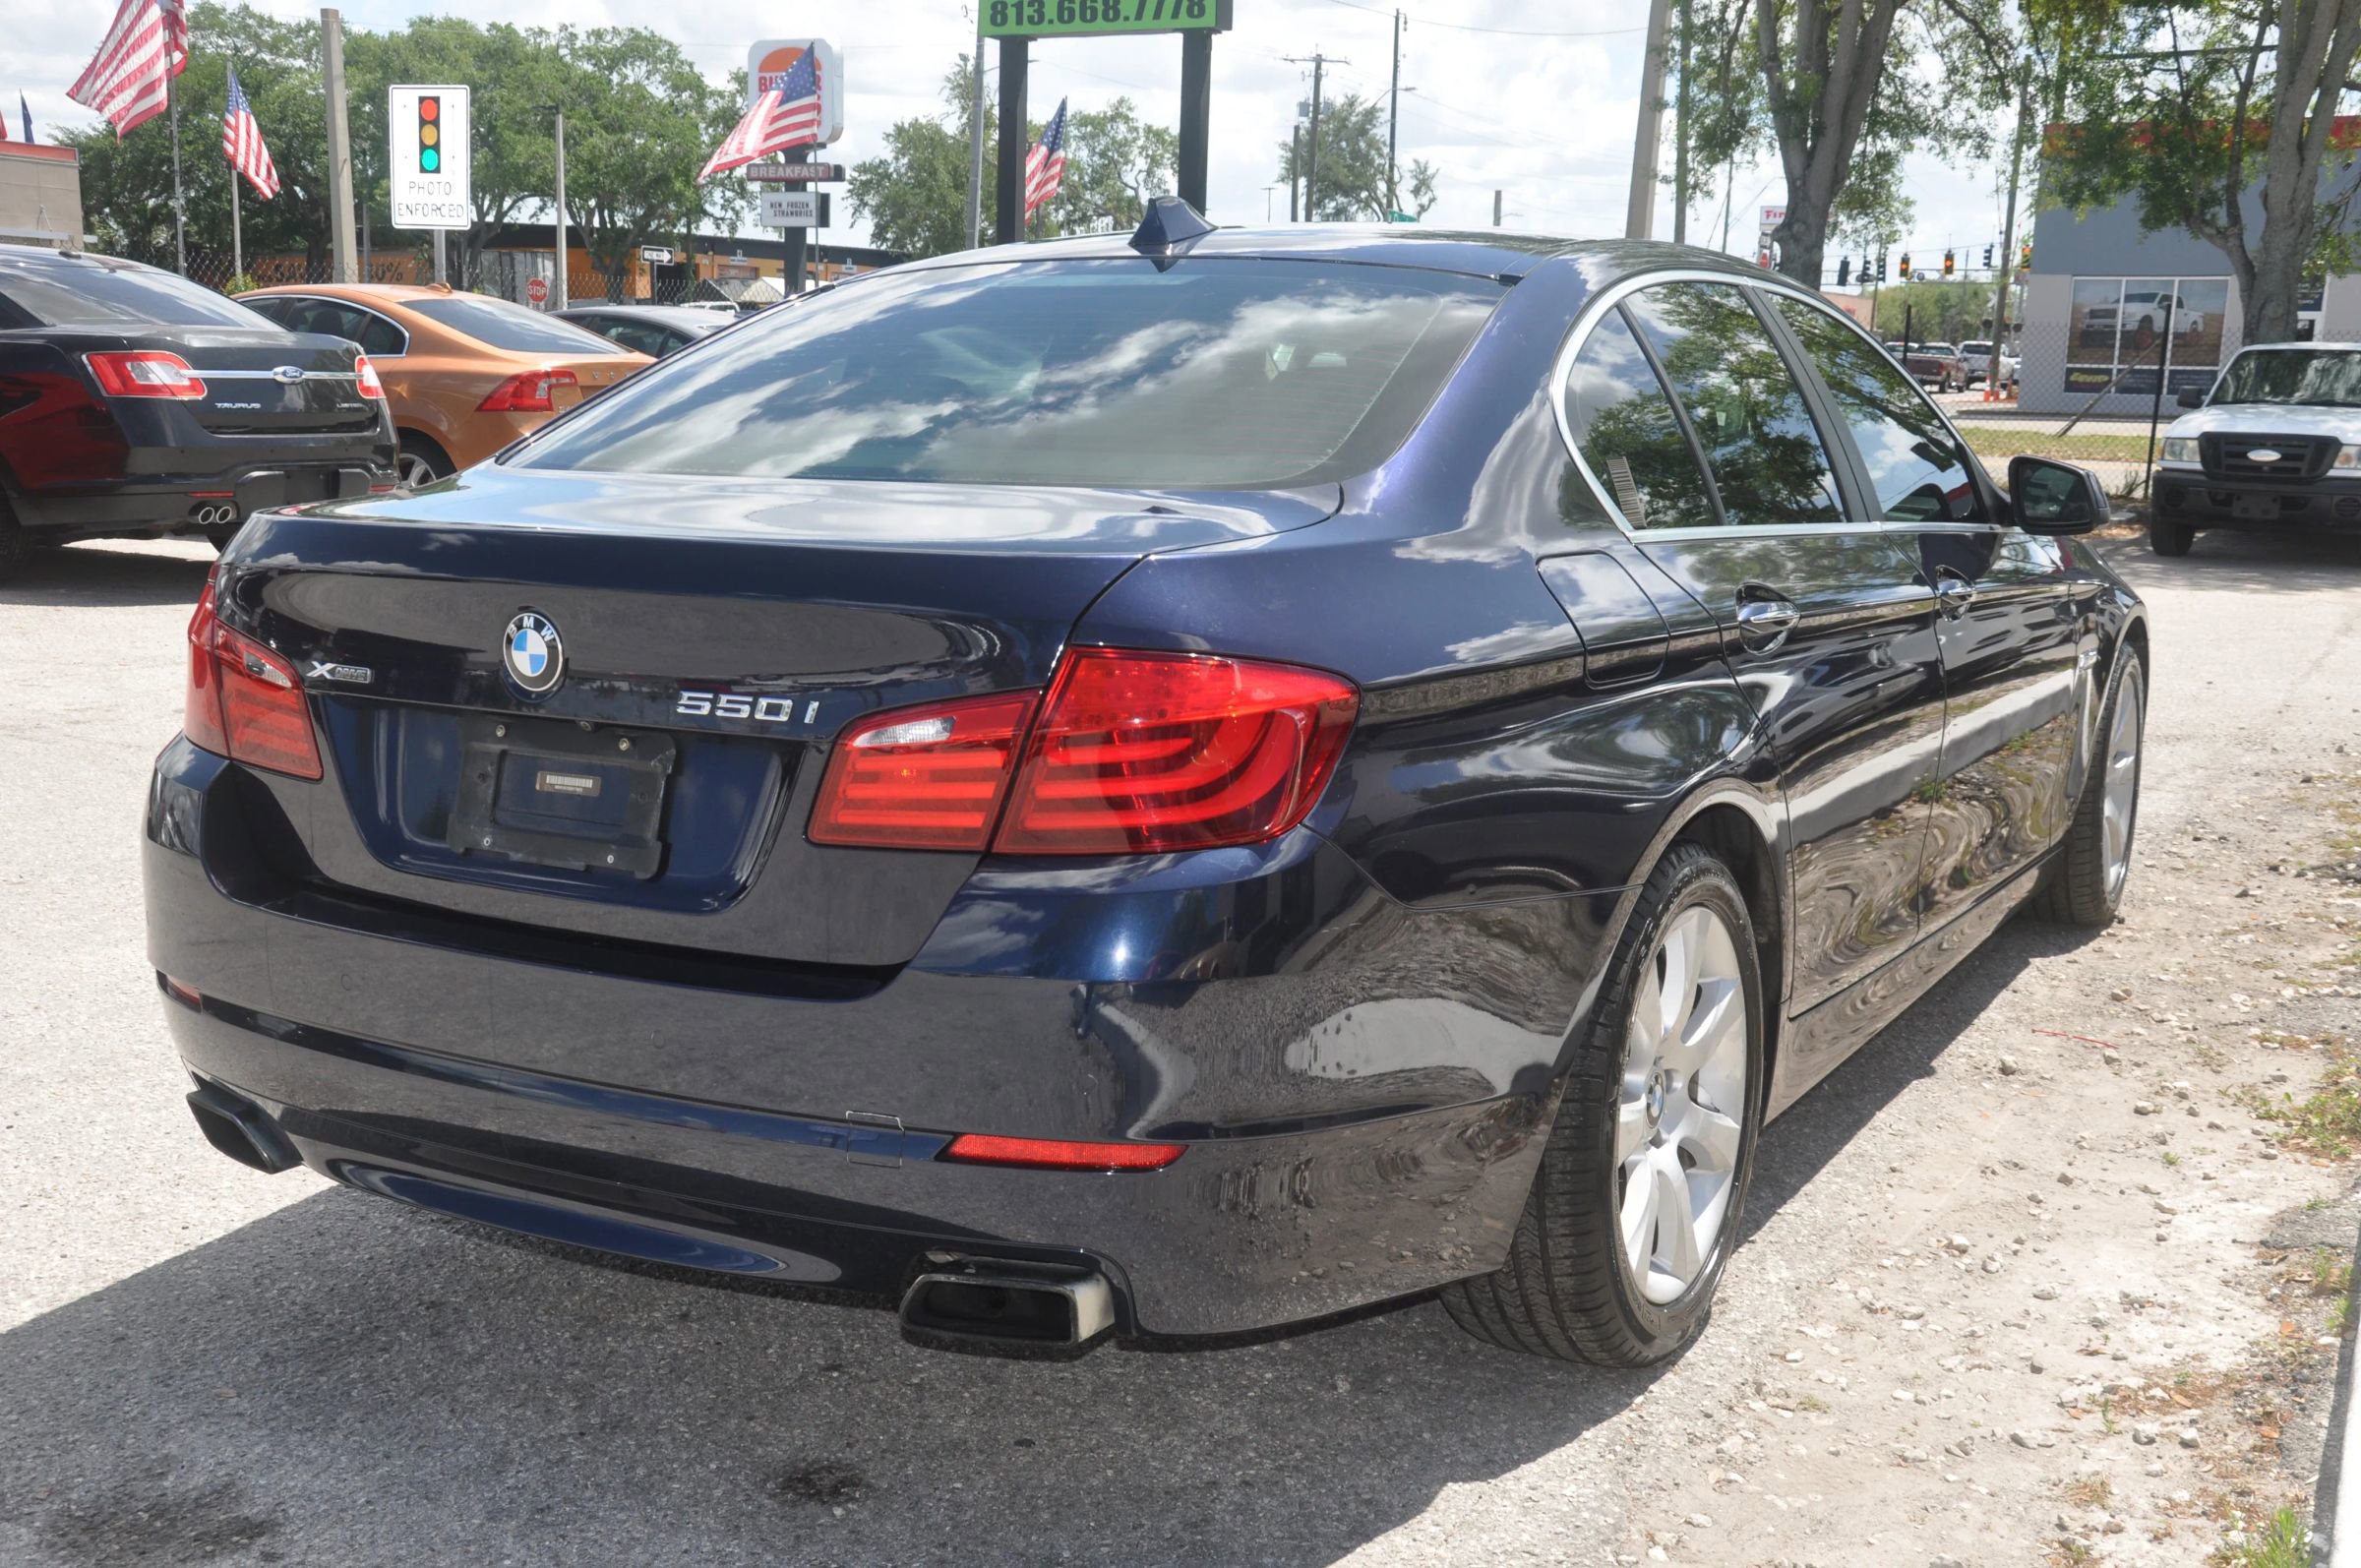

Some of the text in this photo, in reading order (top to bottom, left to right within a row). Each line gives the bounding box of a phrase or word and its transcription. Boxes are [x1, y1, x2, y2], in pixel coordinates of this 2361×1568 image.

[989, 0, 1205, 28] 813.668.7778
[751, 165, 823, 178] BREAKFAST
[408, 181, 452, 196] PHOTO
[397, 203, 464, 218] ENFORCED
[527, 285, 547, 295] STOP
[507, 615, 556, 642] BMW
